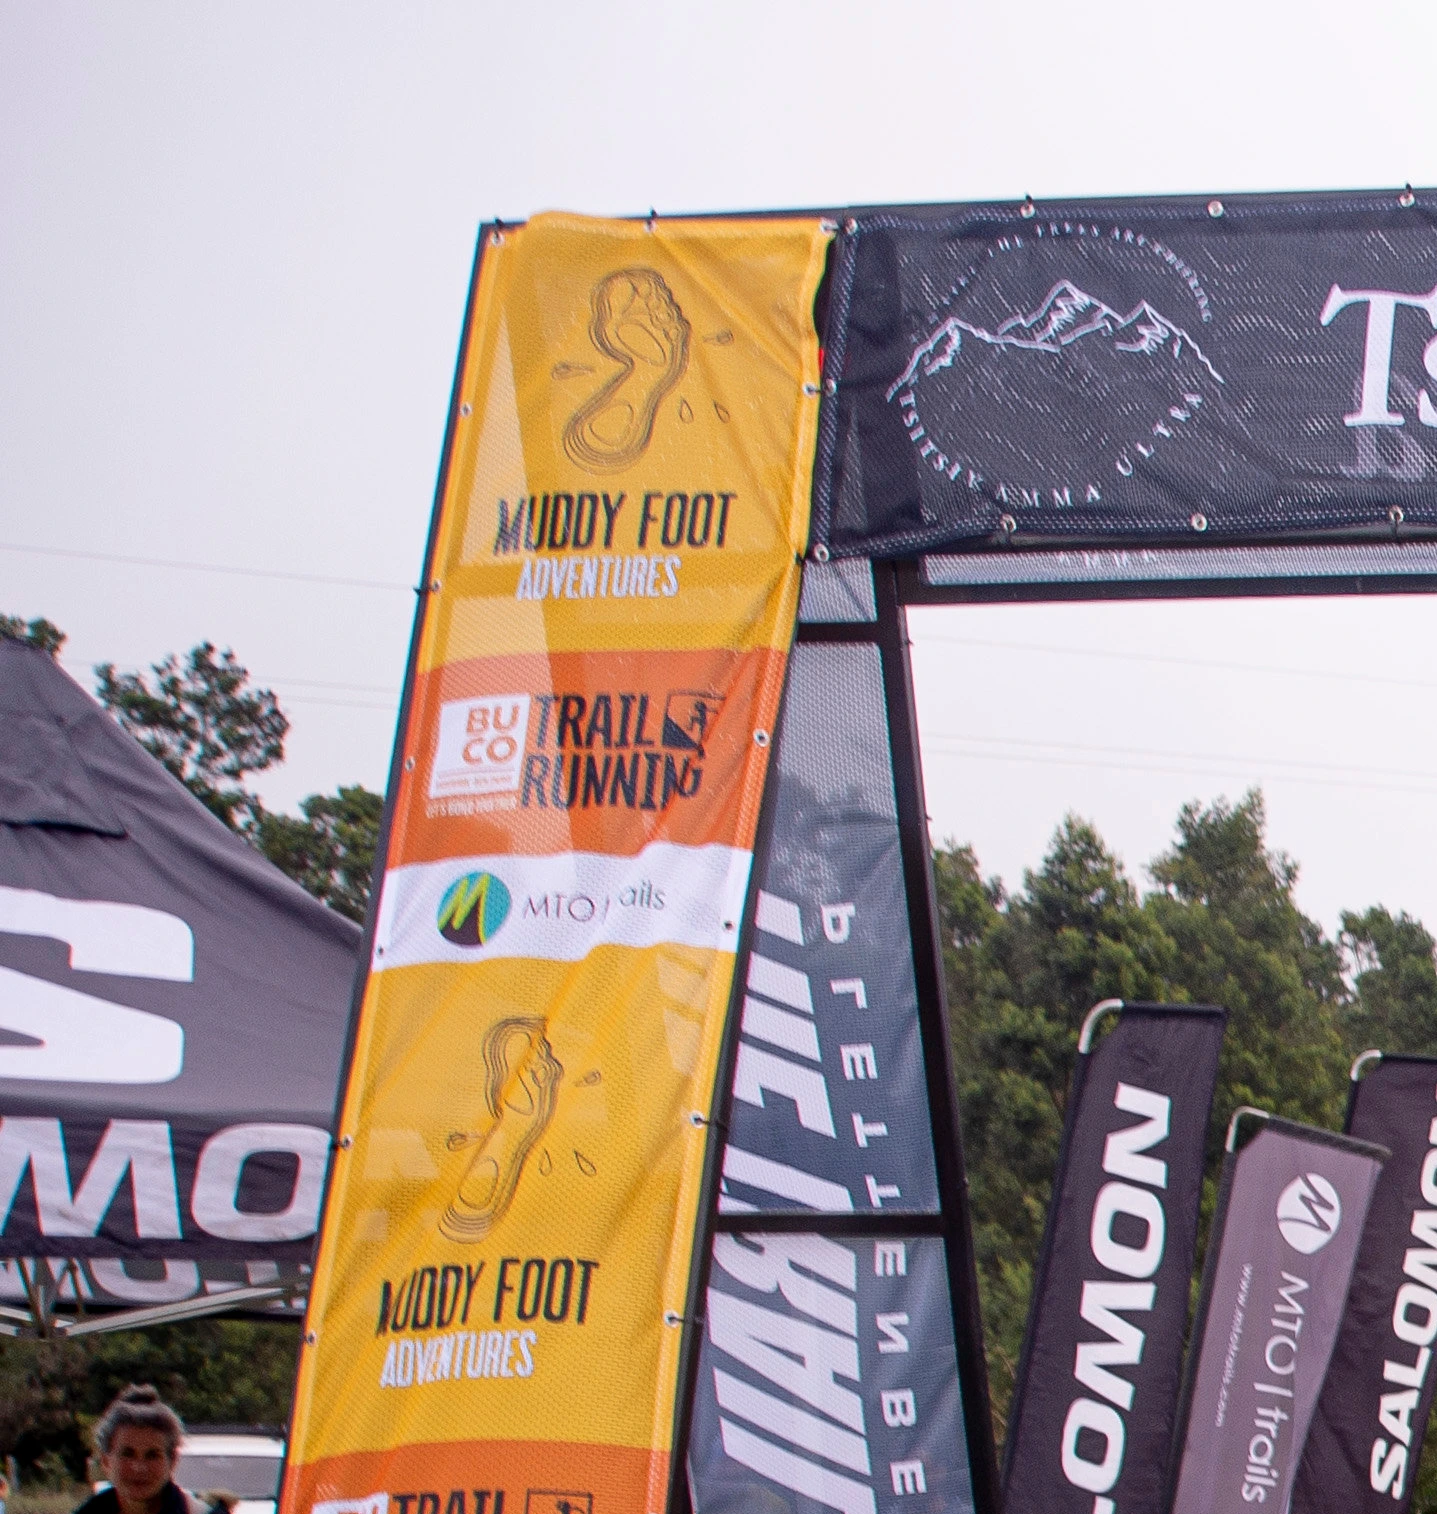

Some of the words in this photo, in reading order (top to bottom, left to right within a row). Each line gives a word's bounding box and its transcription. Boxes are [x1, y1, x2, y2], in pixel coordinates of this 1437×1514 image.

[492, 490, 627, 557] MUDDY
[637, 489, 738, 549] FOOT
[514, 554, 682, 601] ADVENTURES
[535, 693, 654, 750] TRAIL
[618, 880, 666, 910] ails
[493, 1257, 600, 1326] FOOT
[1265, 1270, 1310, 1376] MTO
[379, 1330, 538, 1389] ADVENTURES
[1242, 1406, 1289, 1503] trails
